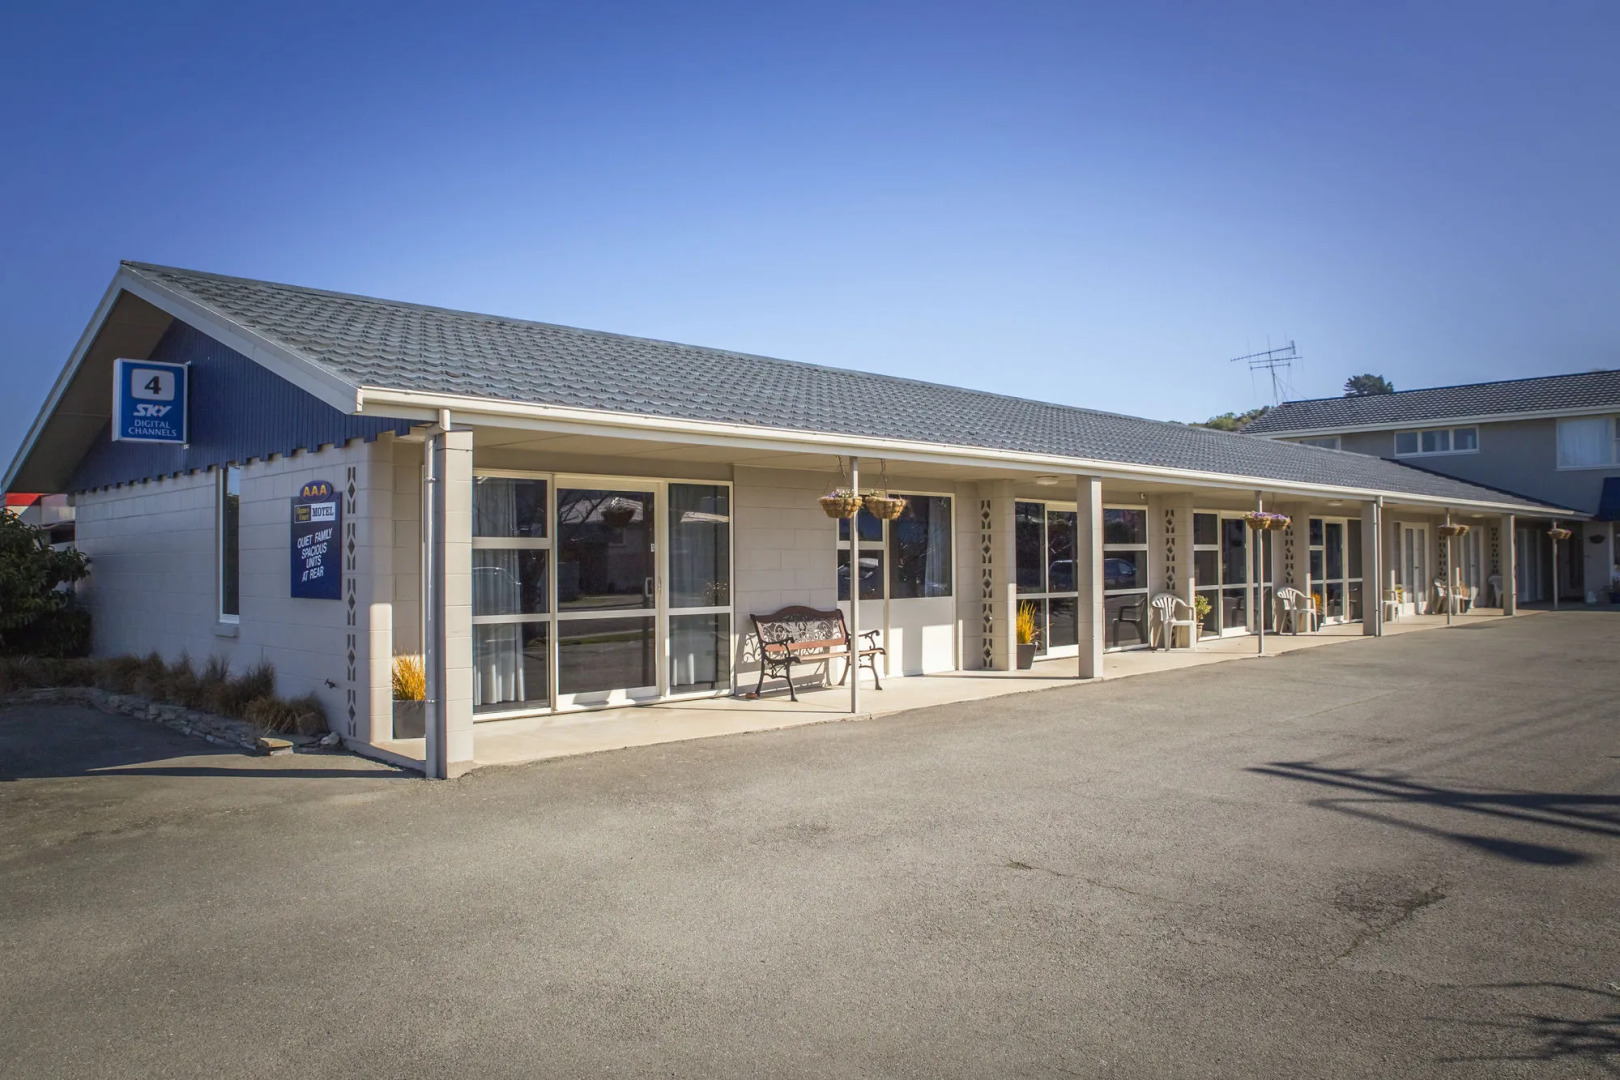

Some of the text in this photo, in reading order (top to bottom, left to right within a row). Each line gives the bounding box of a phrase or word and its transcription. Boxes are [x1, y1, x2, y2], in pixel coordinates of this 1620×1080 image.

[144, 376, 162, 395] 4
[133, 403, 172, 417] SKY
[134, 419, 170, 428] DIGITAL
[128, 427, 177, 437] CHANNELS
[303, 484, 328, 497] AAA
[312, 506, 334, 517] MOTEL
[314, 528, 333, 543] FAMILY
[301, 542, 327, 559] SPACIOUS
[306, 555, 322, 569] UNITS
[302, 566, 324, 582] AT REAR
